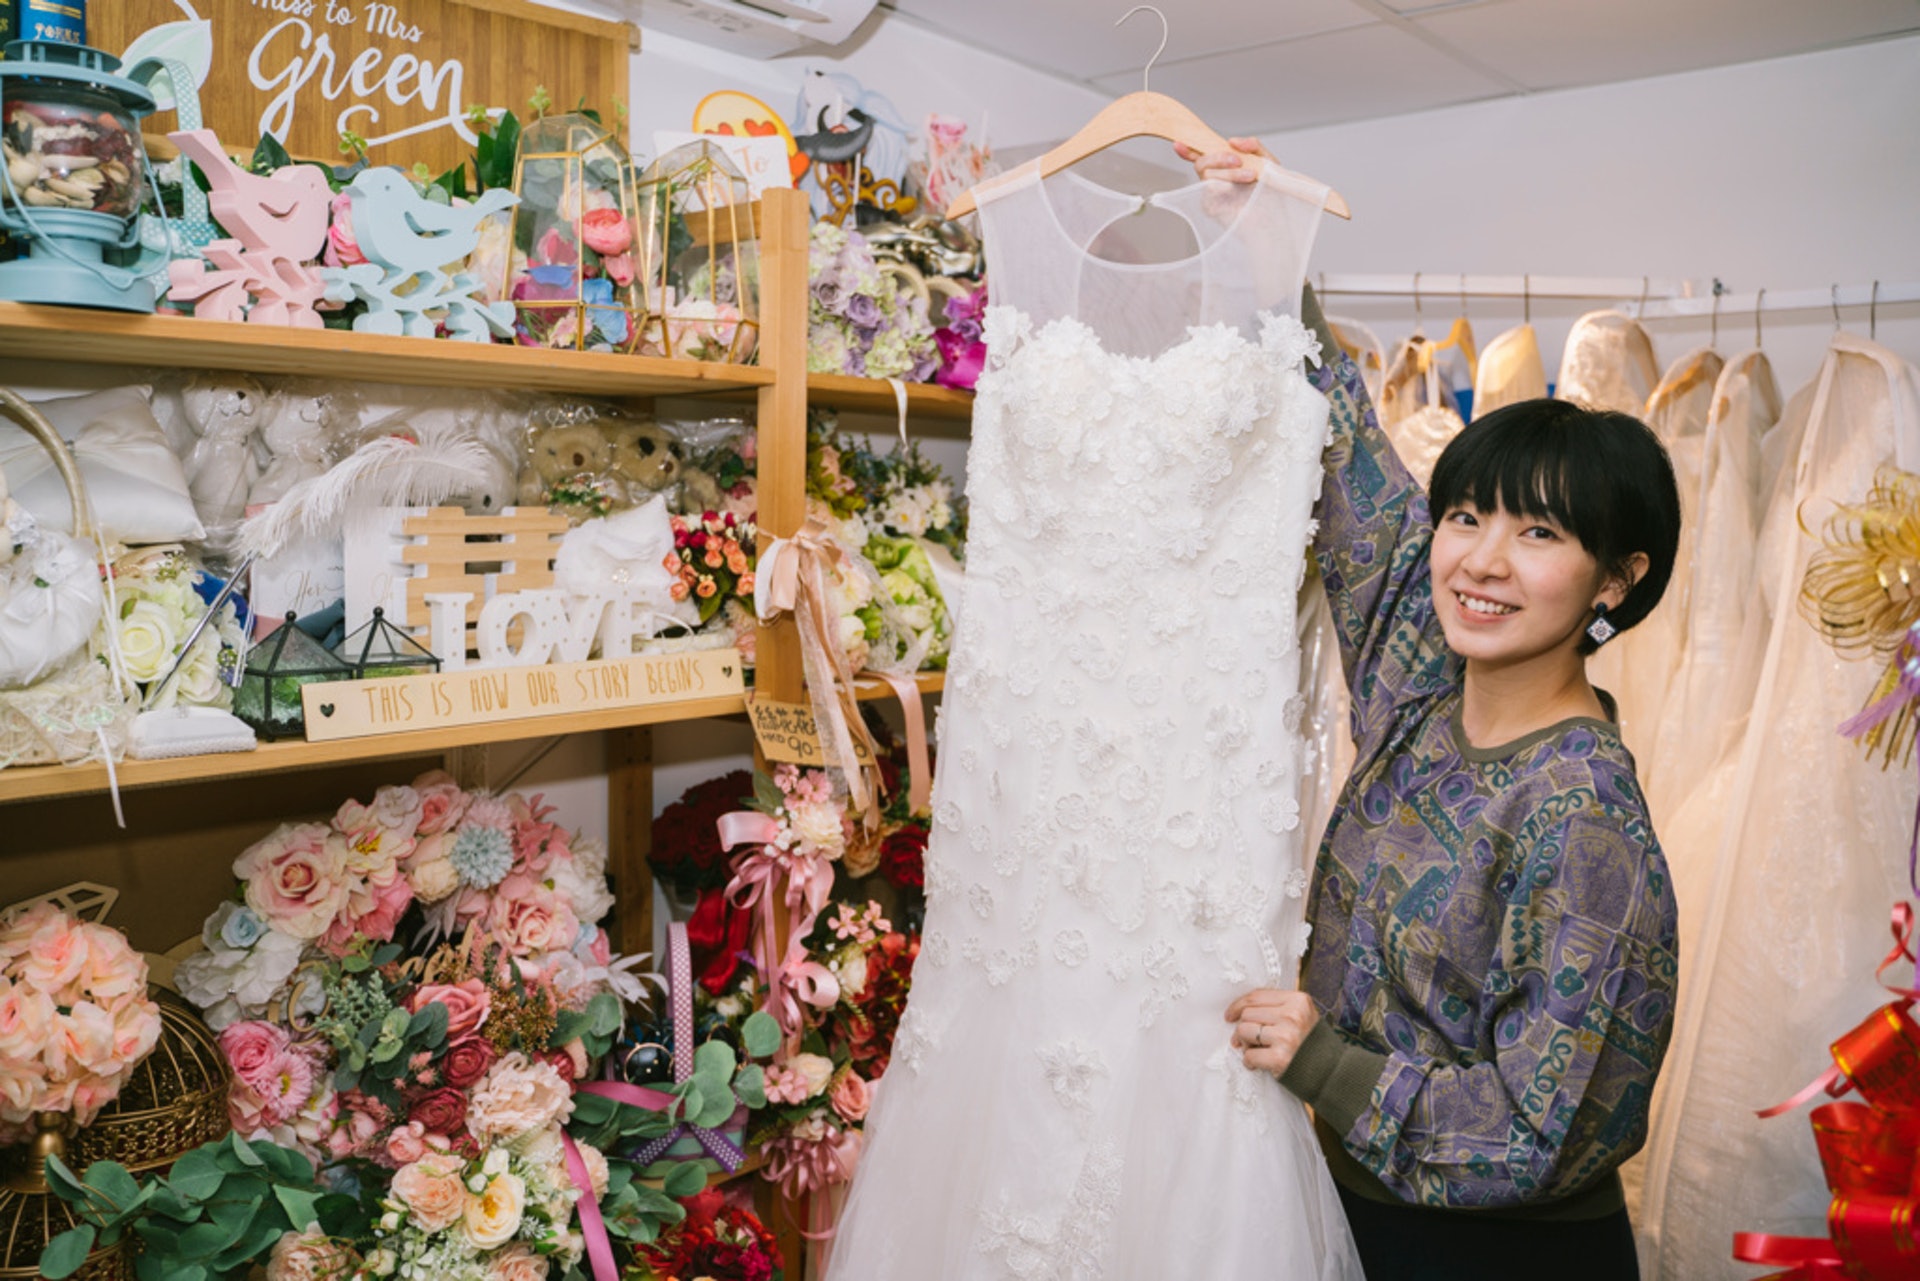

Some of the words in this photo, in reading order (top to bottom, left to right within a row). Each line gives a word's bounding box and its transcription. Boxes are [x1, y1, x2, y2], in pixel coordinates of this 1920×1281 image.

[325, 0, 357, 26] to
[364, 2, 424, 43] Mrs
[362, 683, 414, 724] THIS
[431, 680, 453, 717] IS
[469, 672, 509, 713] HOW
[526, 670, 560, 707] OUR
[575, 663, 630, 702] STORY
[645, 656, 705, 695] BEGINS
